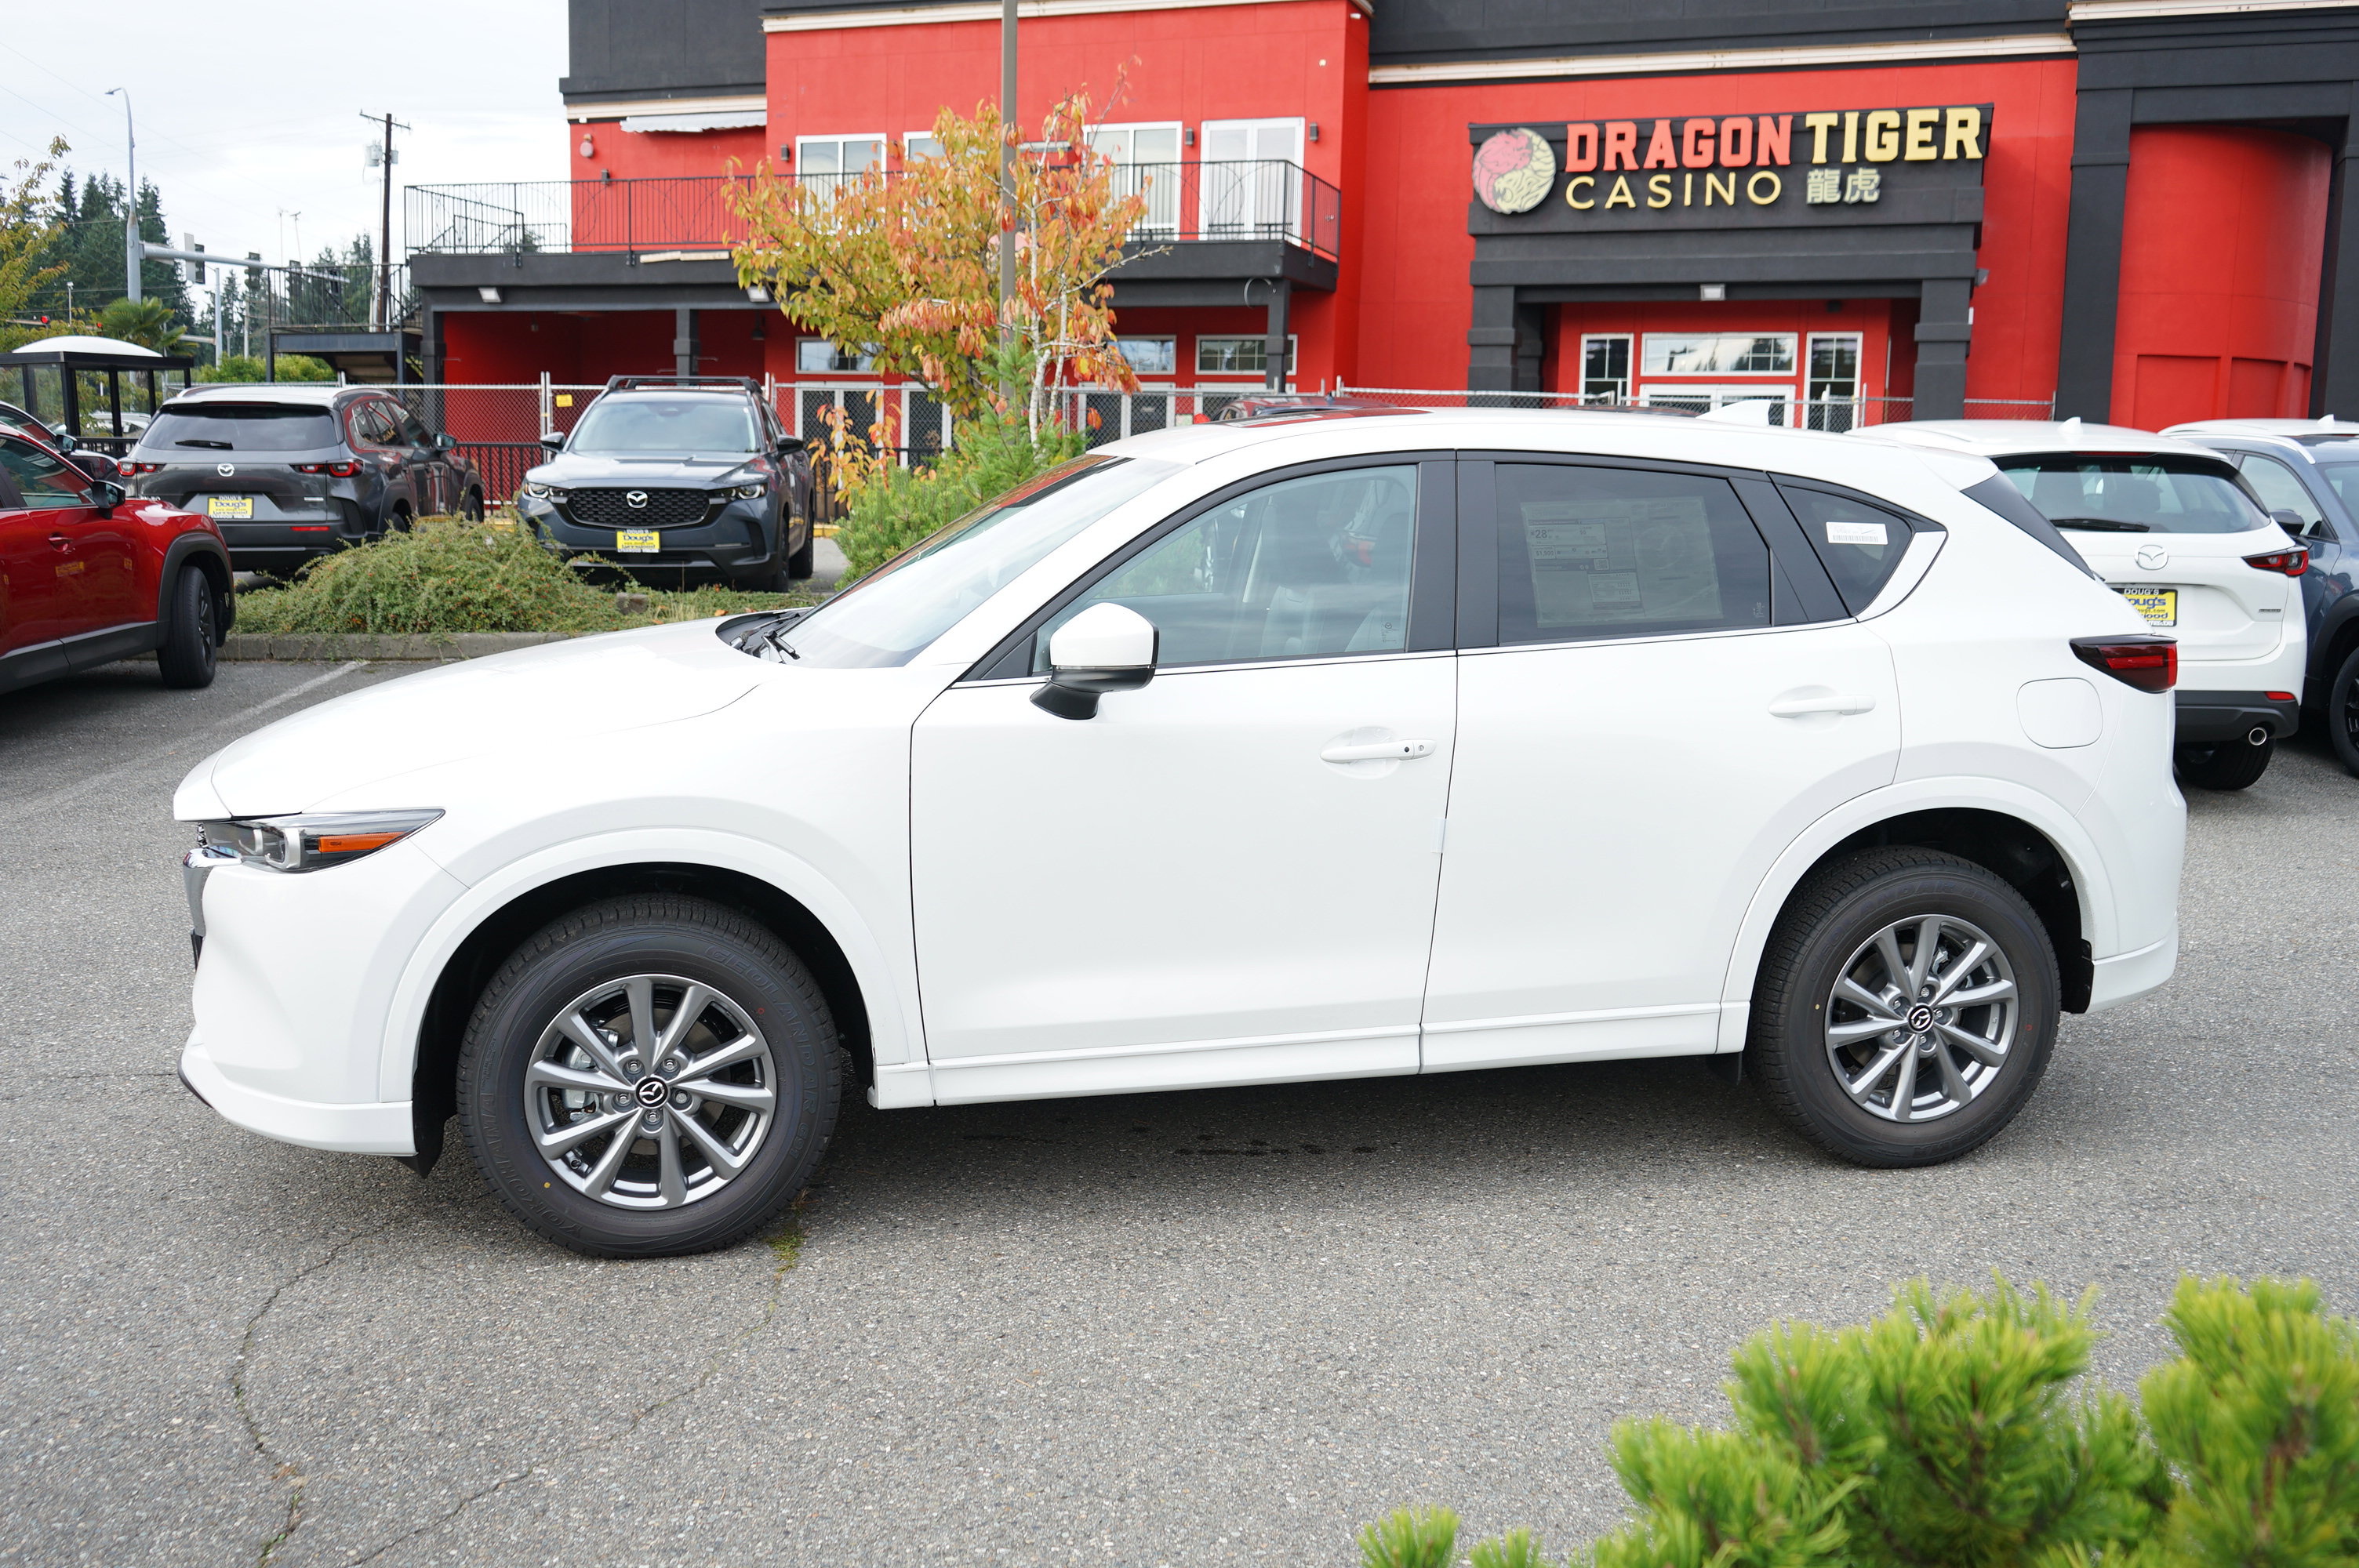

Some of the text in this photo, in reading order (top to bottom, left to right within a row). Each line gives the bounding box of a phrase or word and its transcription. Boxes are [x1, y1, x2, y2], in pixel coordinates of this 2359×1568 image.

[1565, 107, 1983, 172] DRAGON TIGER
[1565, 170, 1782, 210] CASINO
[1806, 167, 1881, 205] 龍虎
[1535, 529, 1548, 539] 28
[2126, 597, 2166, 609] oug's
[705, 945, 818, 1115] GEOLANDAR
[480, 1093, 582, 1238] YOKOHAMA
